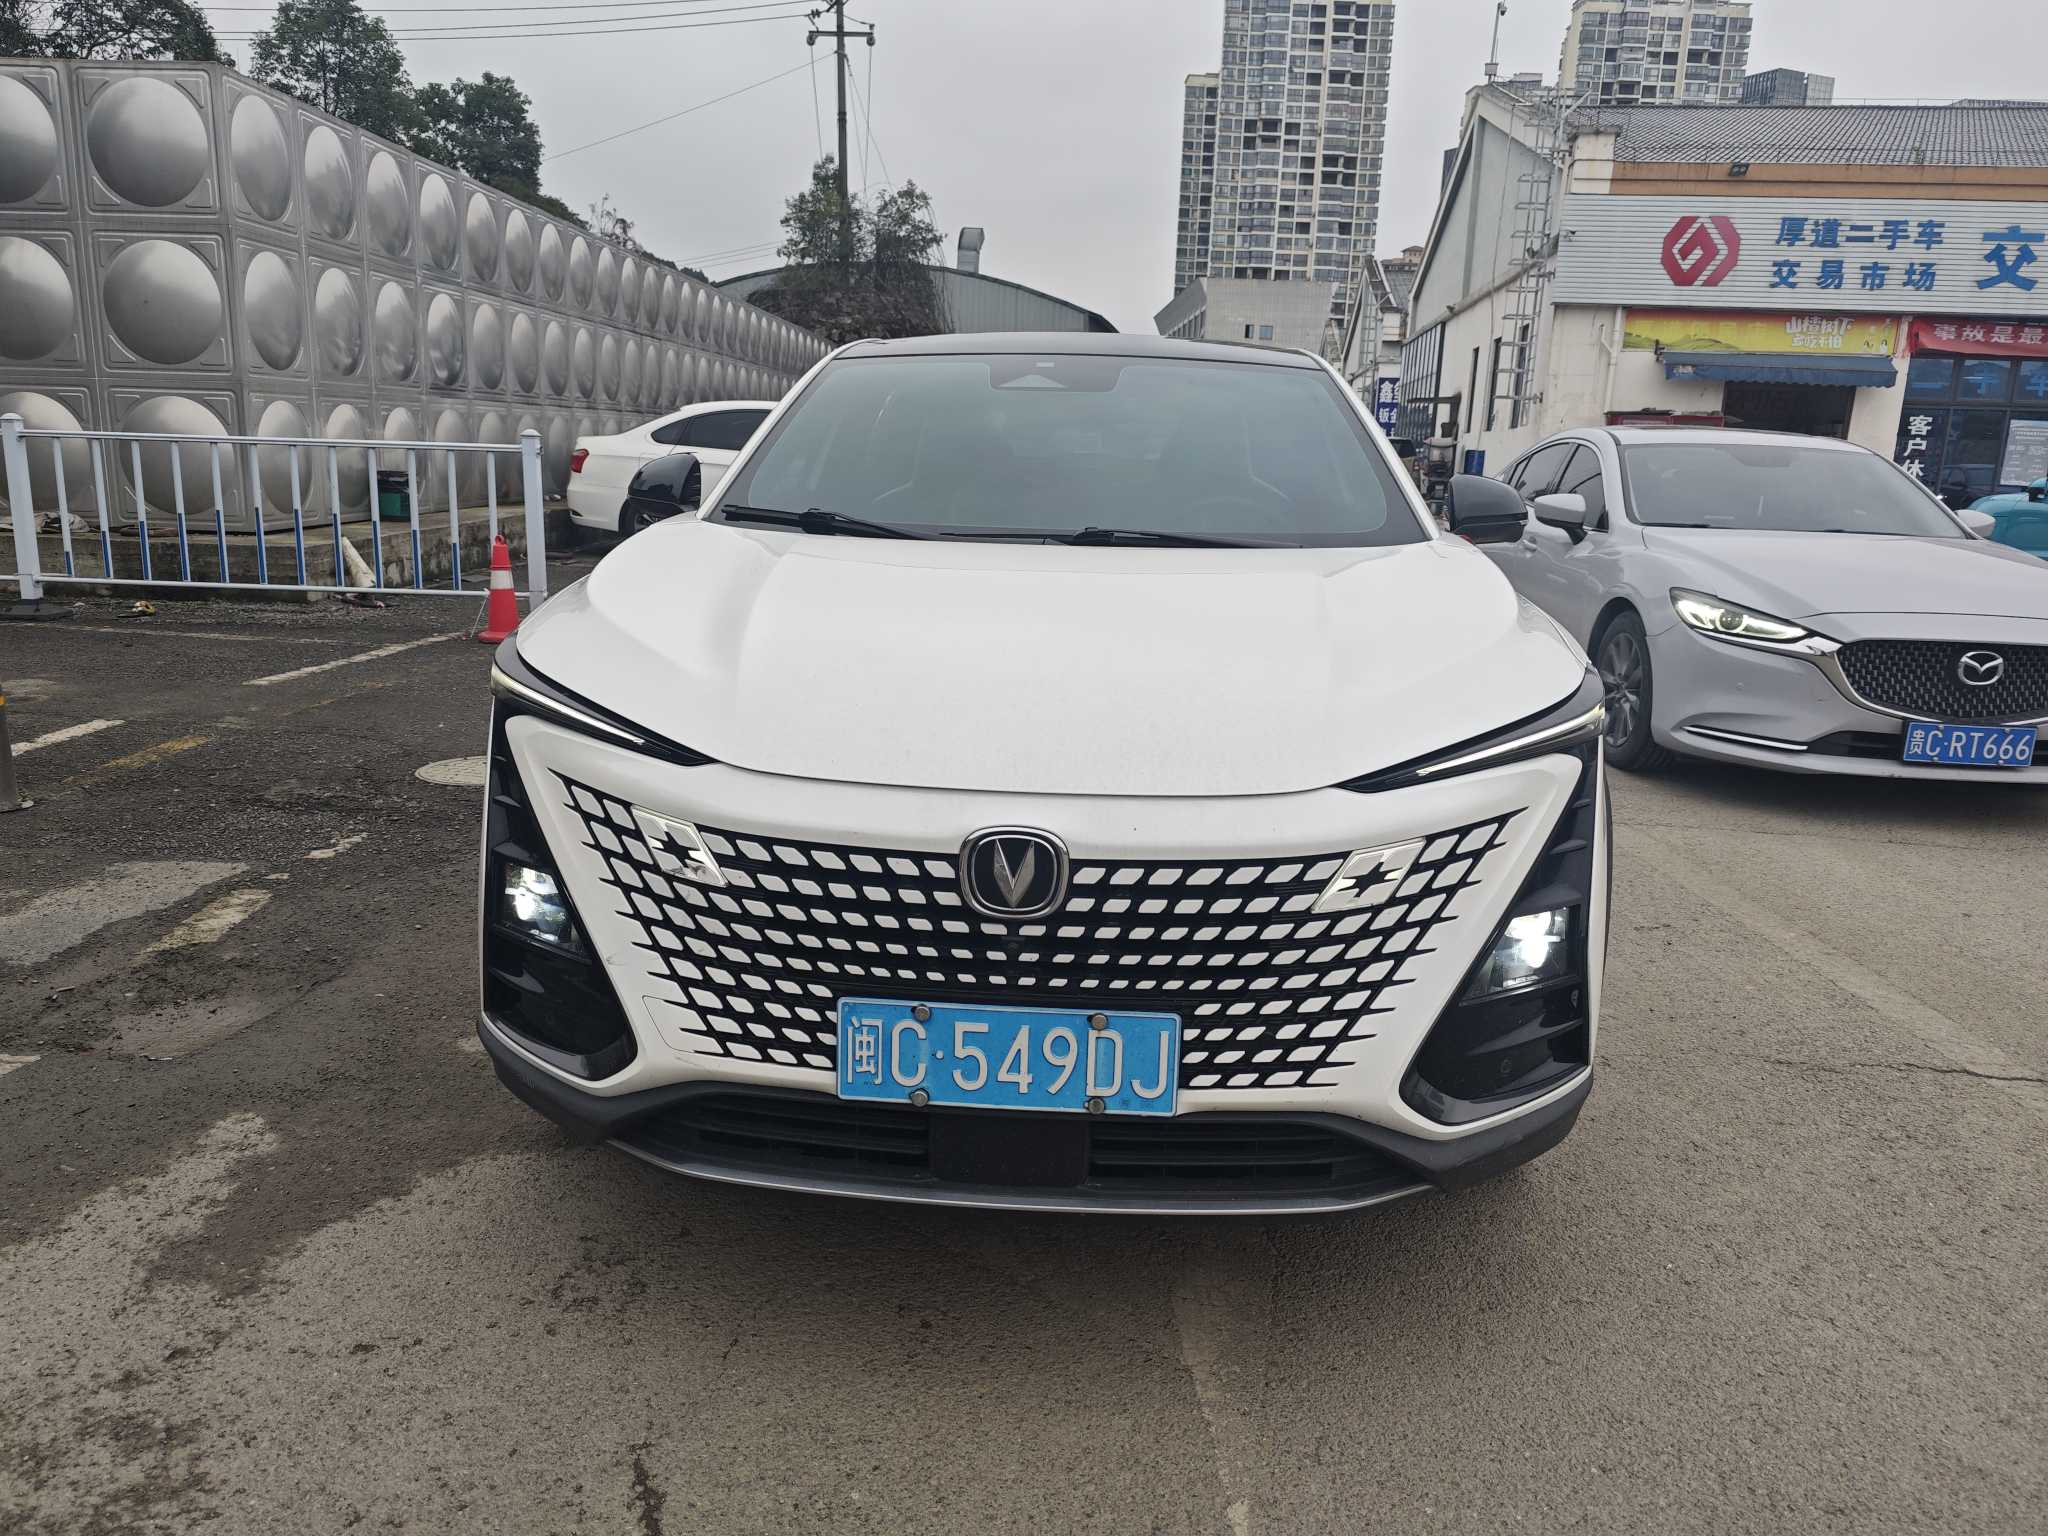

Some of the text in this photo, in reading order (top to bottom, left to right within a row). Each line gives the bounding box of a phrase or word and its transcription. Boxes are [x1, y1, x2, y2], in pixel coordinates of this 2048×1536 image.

[1775, 215, 1947, 251] 厚道二手车
[1976, 224, 2046, 292] 交
[1769, 258, 1937, 292] 交易市场
[846, 1015, 1169, 1100] 闽C·549DJ
